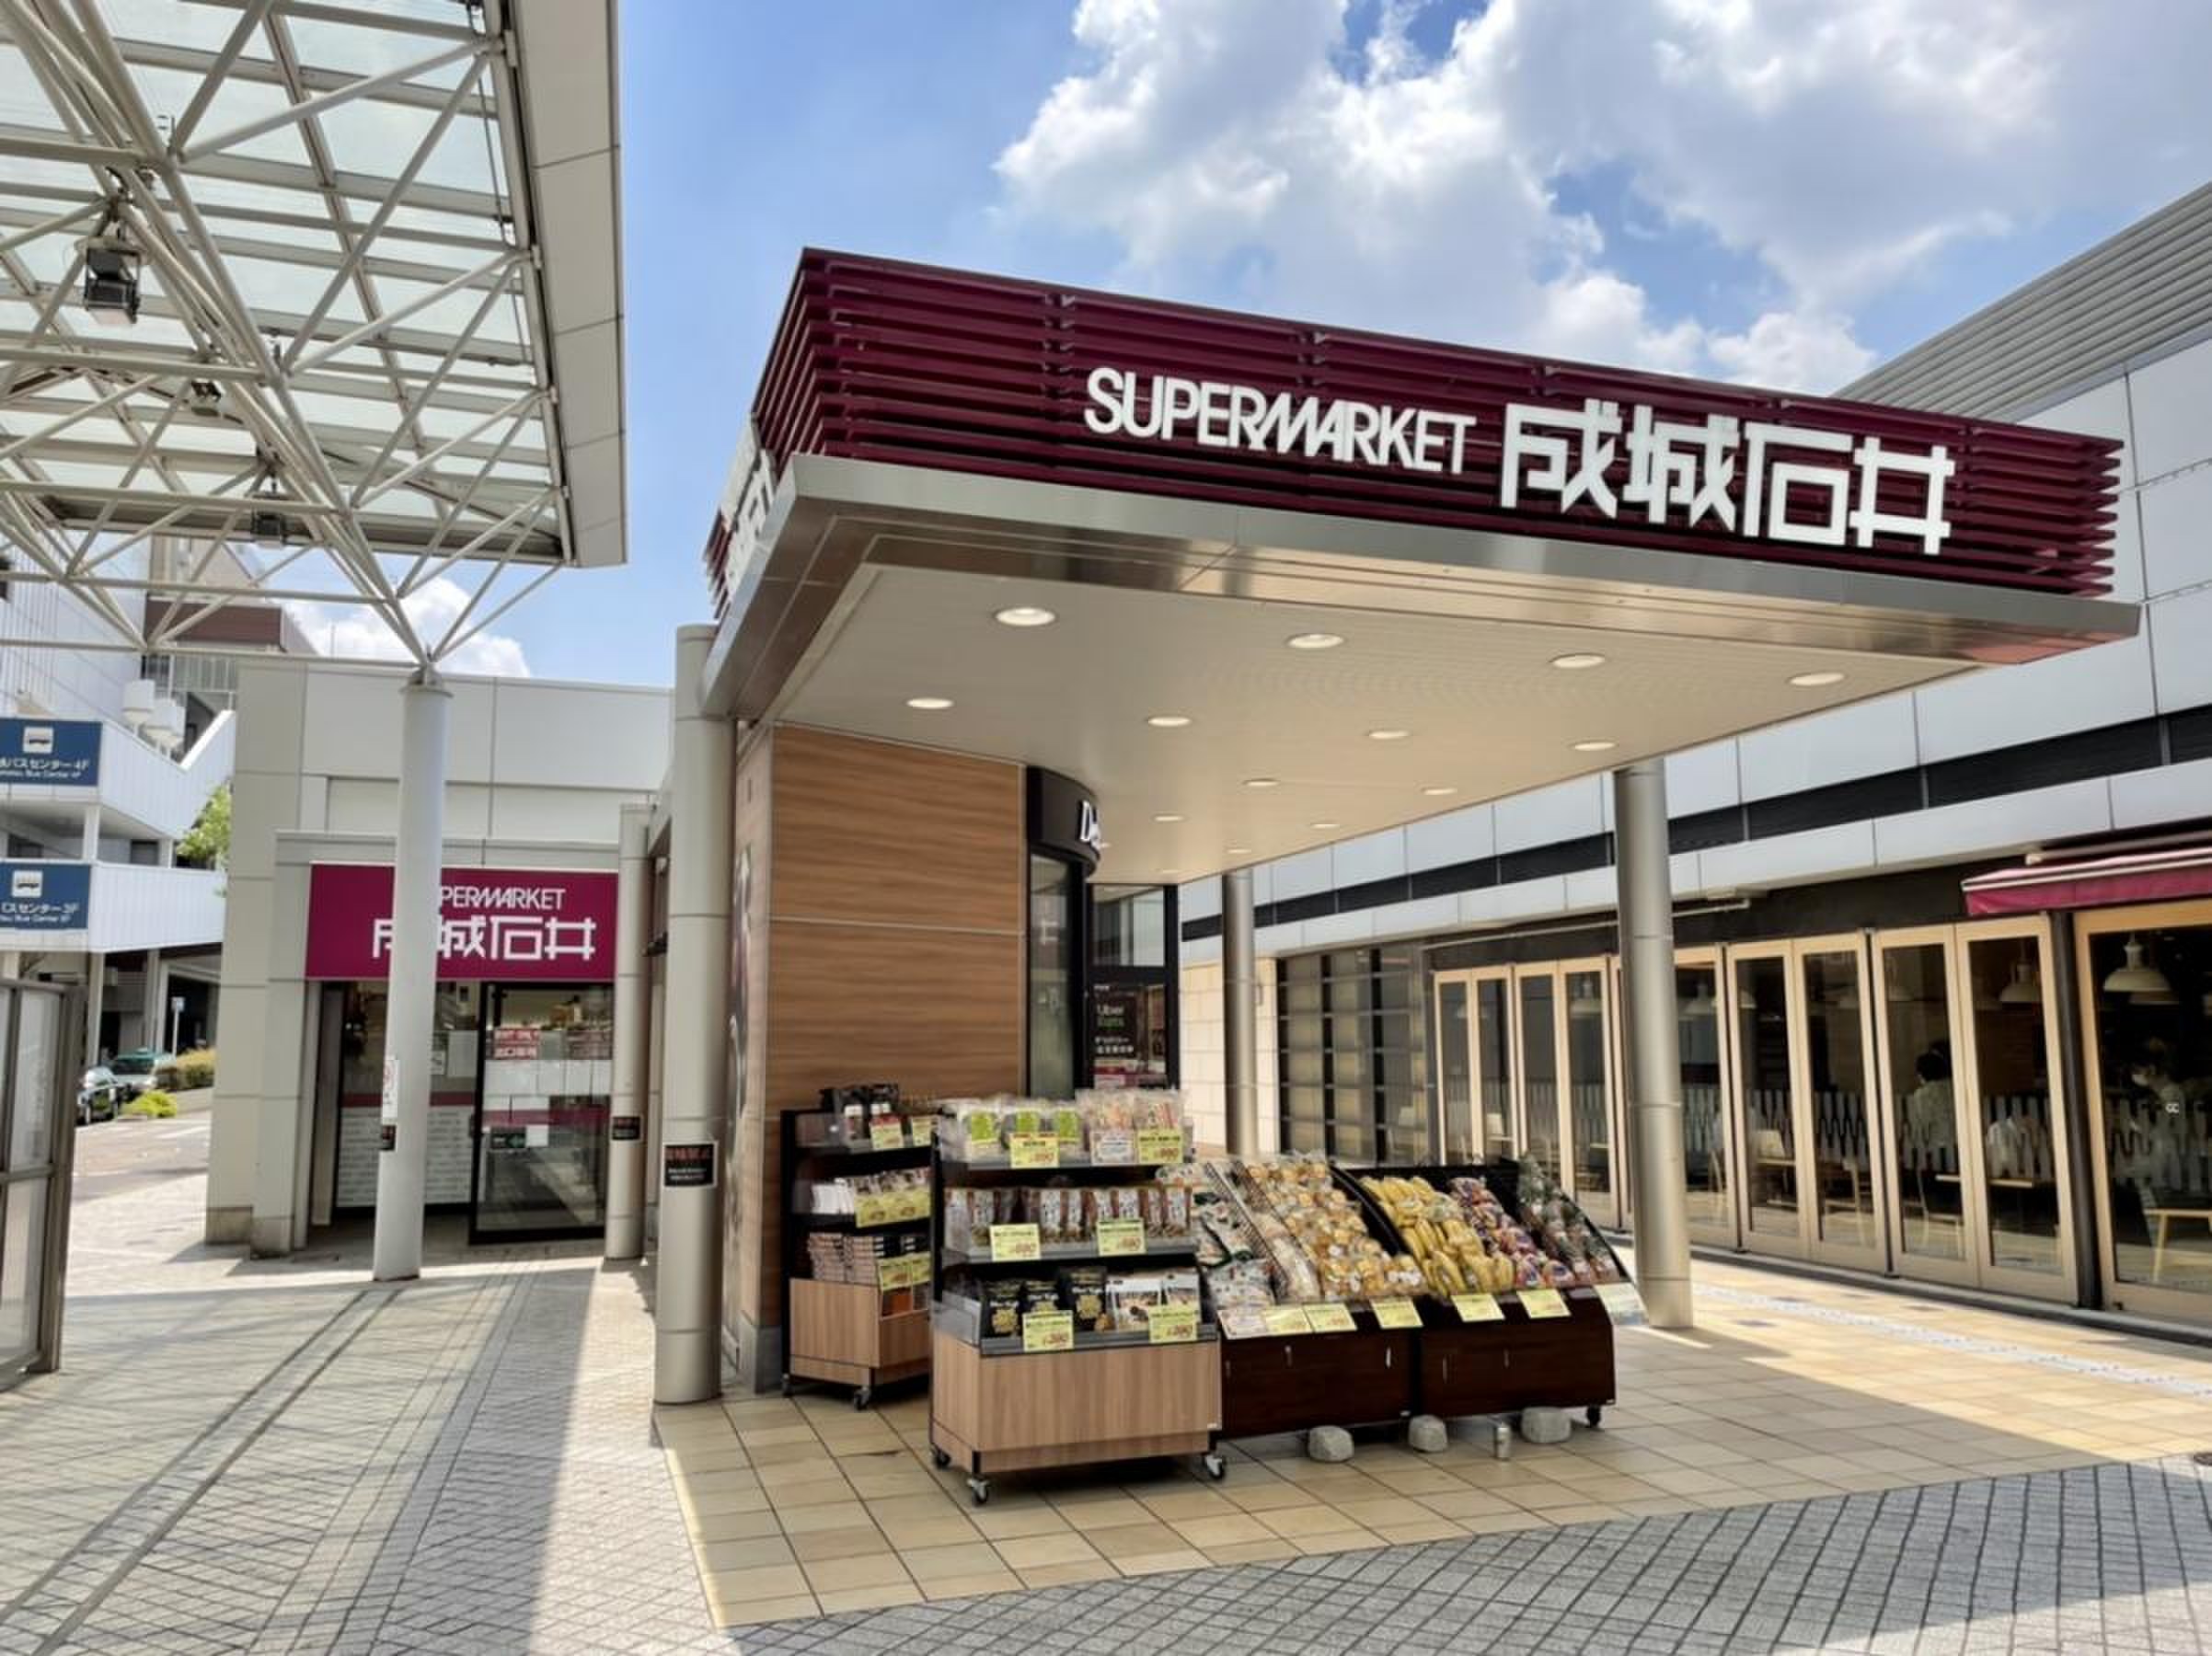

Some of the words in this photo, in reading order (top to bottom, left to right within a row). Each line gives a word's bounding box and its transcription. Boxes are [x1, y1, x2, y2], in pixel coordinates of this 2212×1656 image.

[1084, 367, 1477, 474] SUPERMARKET
[1501, 397, 1956, 556] 成城石井
[441, 886, 566, 910] PERMARKET
